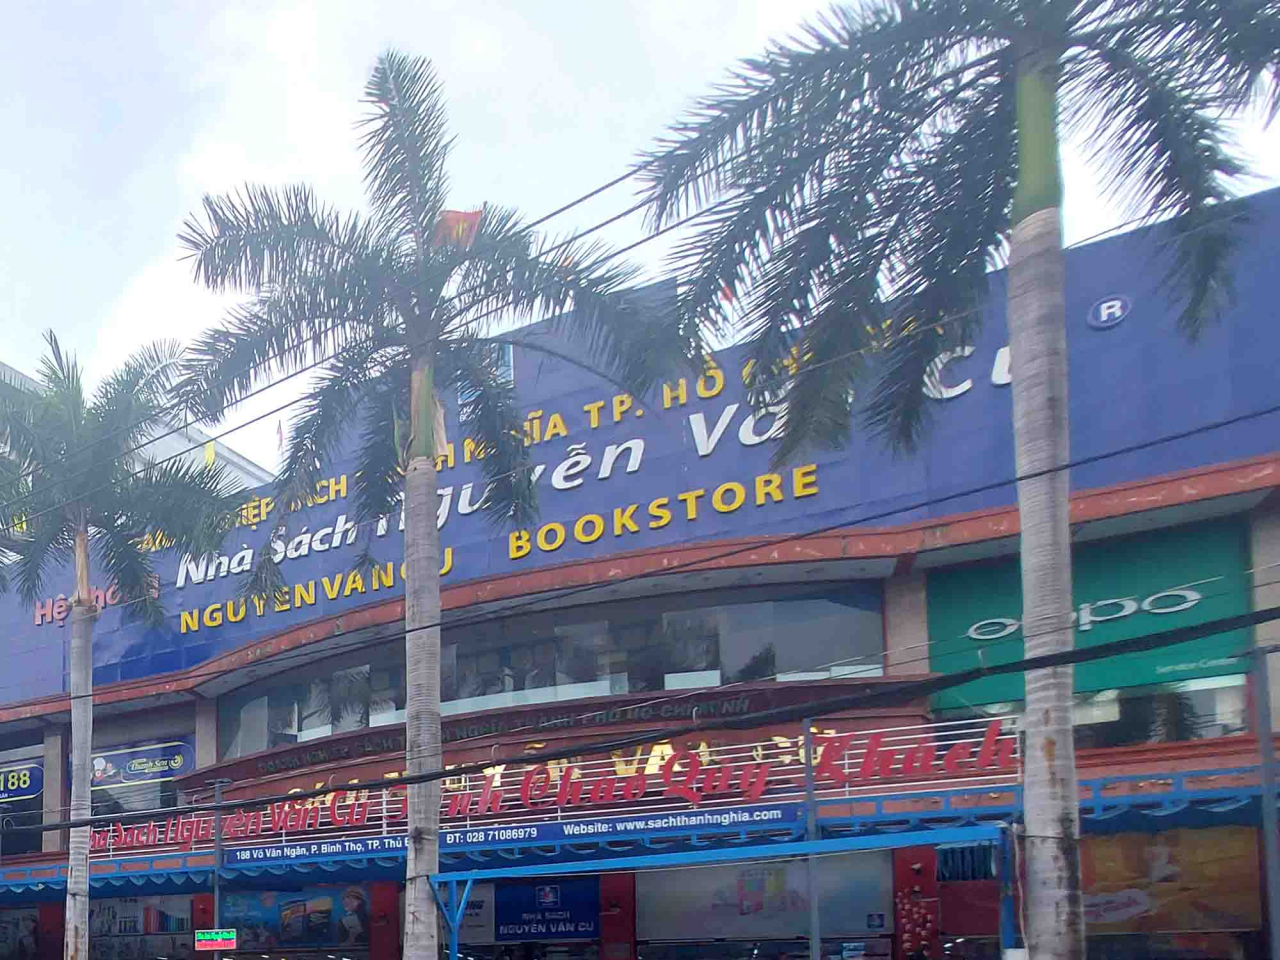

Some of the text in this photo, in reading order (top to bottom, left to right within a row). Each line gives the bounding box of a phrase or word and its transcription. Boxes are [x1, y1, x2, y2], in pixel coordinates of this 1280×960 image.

[583, 393, 644, 429] TP.
[509, 464, 819, 560] BOOKSTORE
[34, 594, 69, 628] Hệ
[968, 589, 1202, 640] opo
[236, 850, 251, 860] 188
[265, 846, 282, 858] Văn
[311, 844, 320, 854] P.
[321, 841, 342, 853] Bình
[367, 839, 381, 850] TP.
[384, 837, 402, 849] Thủ
[446, 832, 464, 844] ĐT:
[467, 830, 485, 842] 028
[488, 827, 538, 841] 71086979
[563, 820, 613, 836] Website:
[616, 808, 782, 831] www.sachthanhnghia.com
